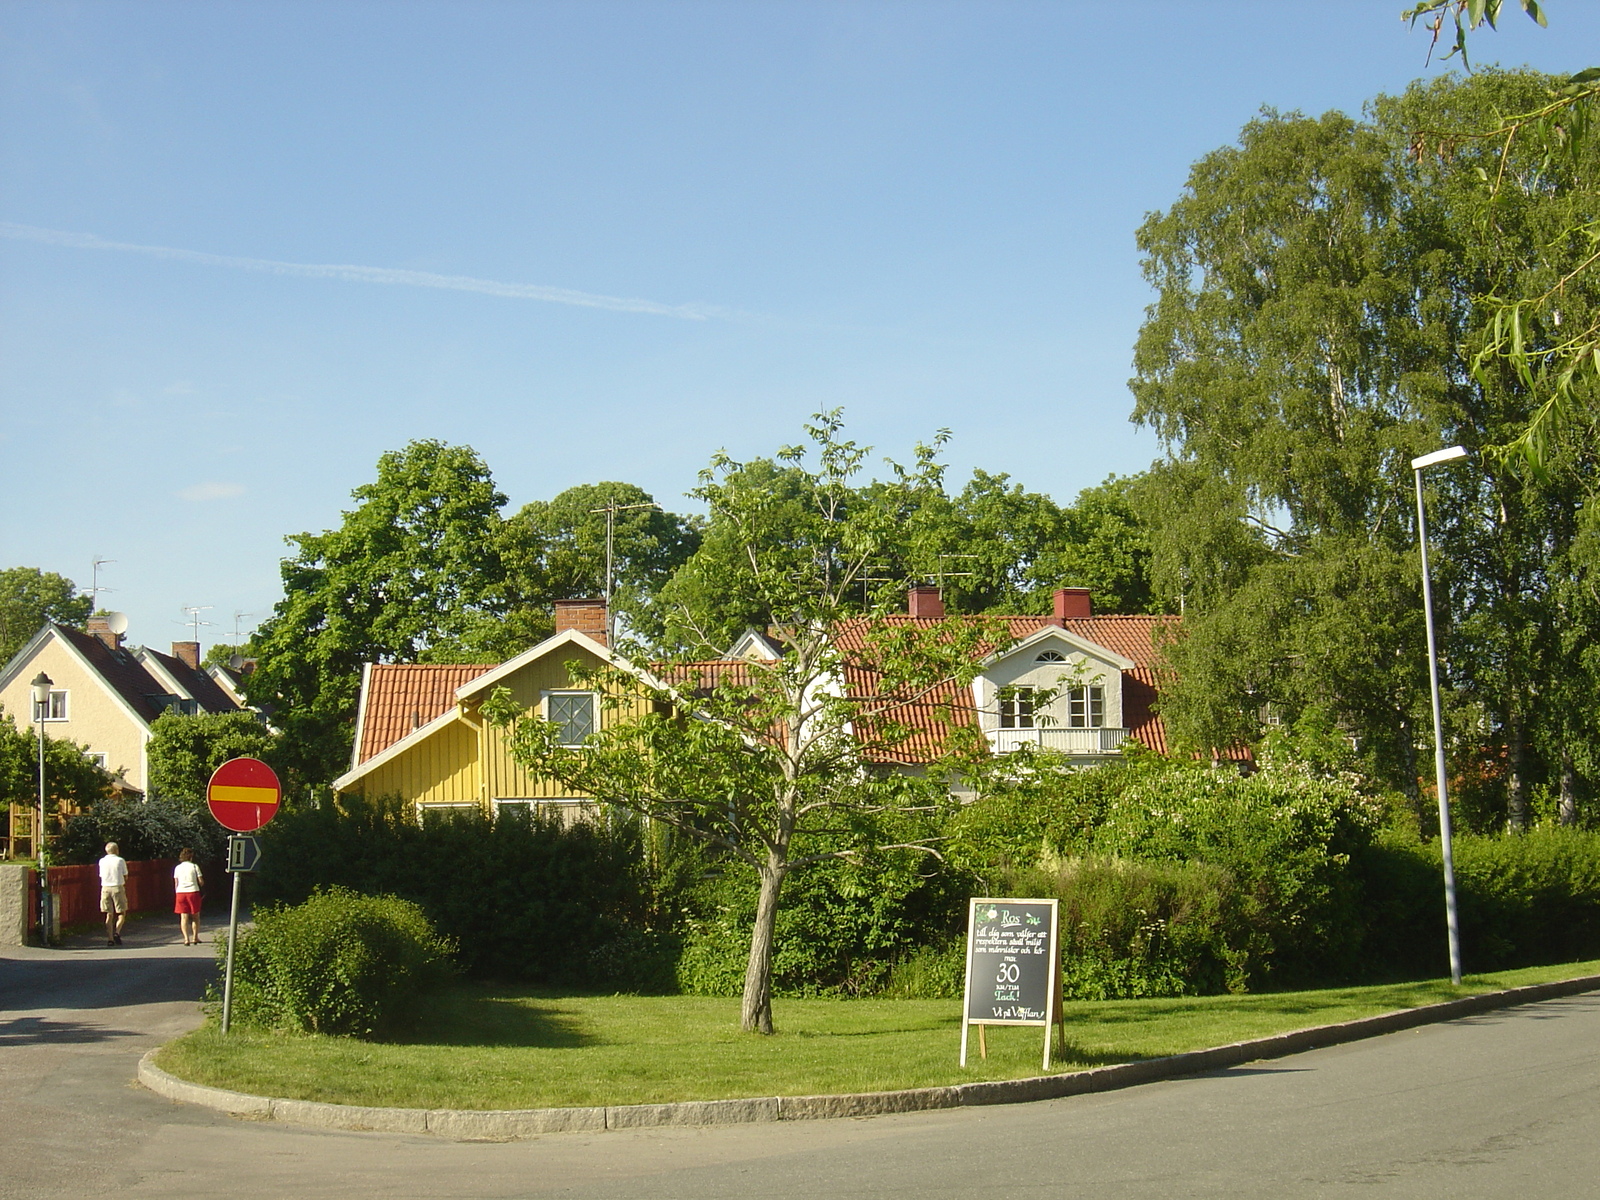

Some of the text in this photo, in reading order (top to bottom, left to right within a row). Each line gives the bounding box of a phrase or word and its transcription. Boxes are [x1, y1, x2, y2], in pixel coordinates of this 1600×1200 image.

[1000, 909, 1021, 924] Ros
[976, 926, 988, 937] till
[988, 926, 1000, 940] dig
[975, 936, 1008, 947] respektera
[1020, 946, 1031, 954] och
[996, 962, 1020, 983] 30
[994, 990, 1020, 1002] Tack!
[992, 1006, 1003, 1017] Vi
[1003, 1008, 1011, 1019] på
